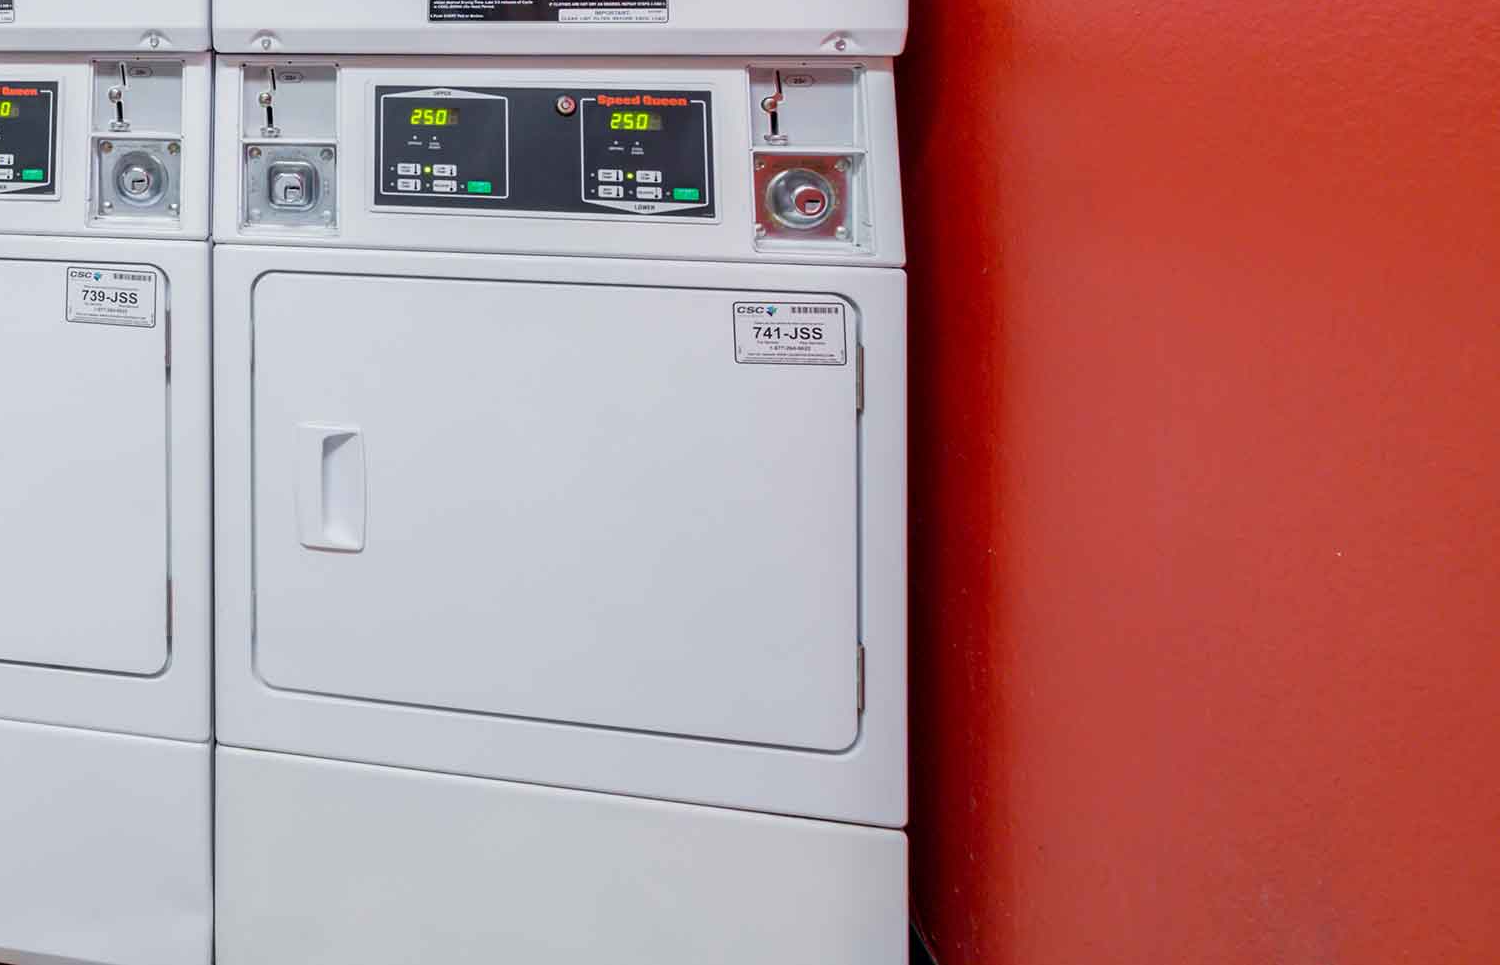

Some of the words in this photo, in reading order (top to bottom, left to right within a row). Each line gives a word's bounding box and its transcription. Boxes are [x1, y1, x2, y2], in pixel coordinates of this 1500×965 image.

[1, 86, 38, 97] Queen
[597, 94, 641, 107] Speed
[643, 95, 688, 107] Queen
[411, 109, 447, 125] 250
[610, 113, 648, 130] 250
[82, 289, 138, 304] 739-JSS
[736, 306, 765, 314] CSC
[752, 326, 823, 340] 741-JSS
